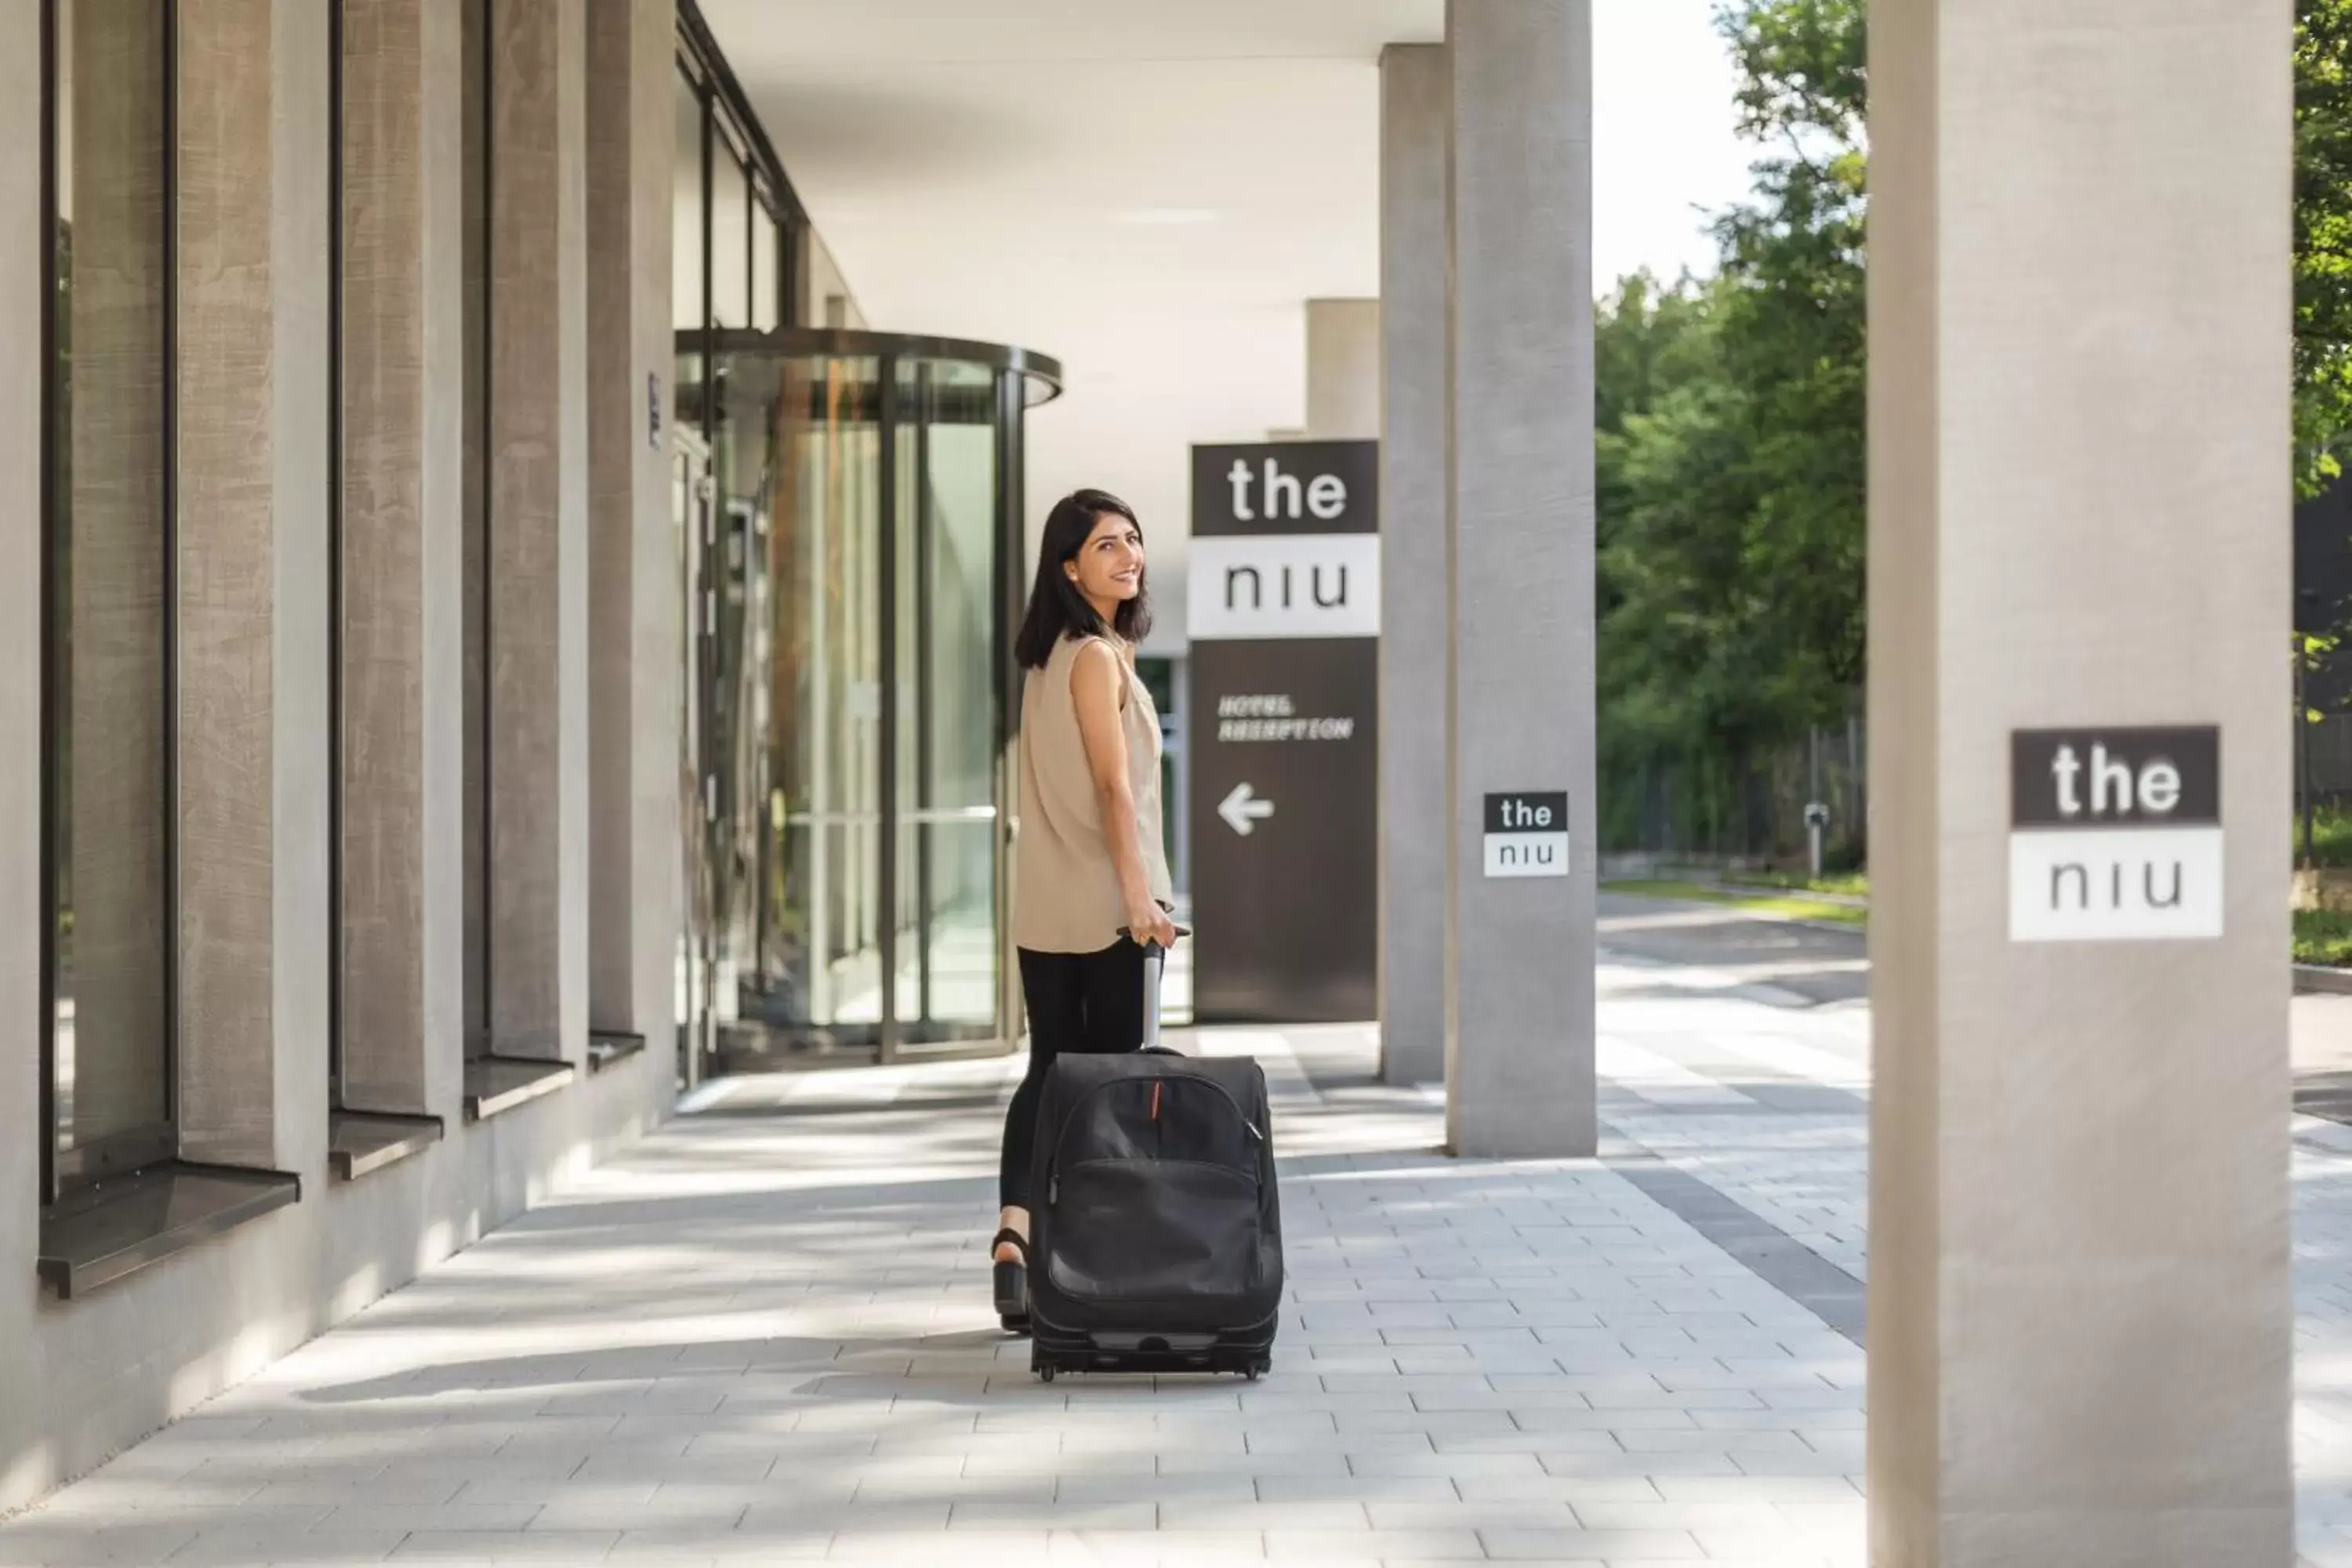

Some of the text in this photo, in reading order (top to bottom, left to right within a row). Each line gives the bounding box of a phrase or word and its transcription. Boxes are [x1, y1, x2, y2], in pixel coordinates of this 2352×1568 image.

[1227, 457, 1347, 521] the
[1225, 562, 1347, 608] niu
[1218, 717, 1354, 742] PTION
[2050, 742, 2181, 814] the
[1501, 799, 1552, 827] the
[1500, 844, 1552, 865] niu
[2049, 860, 2181, 910] niu
